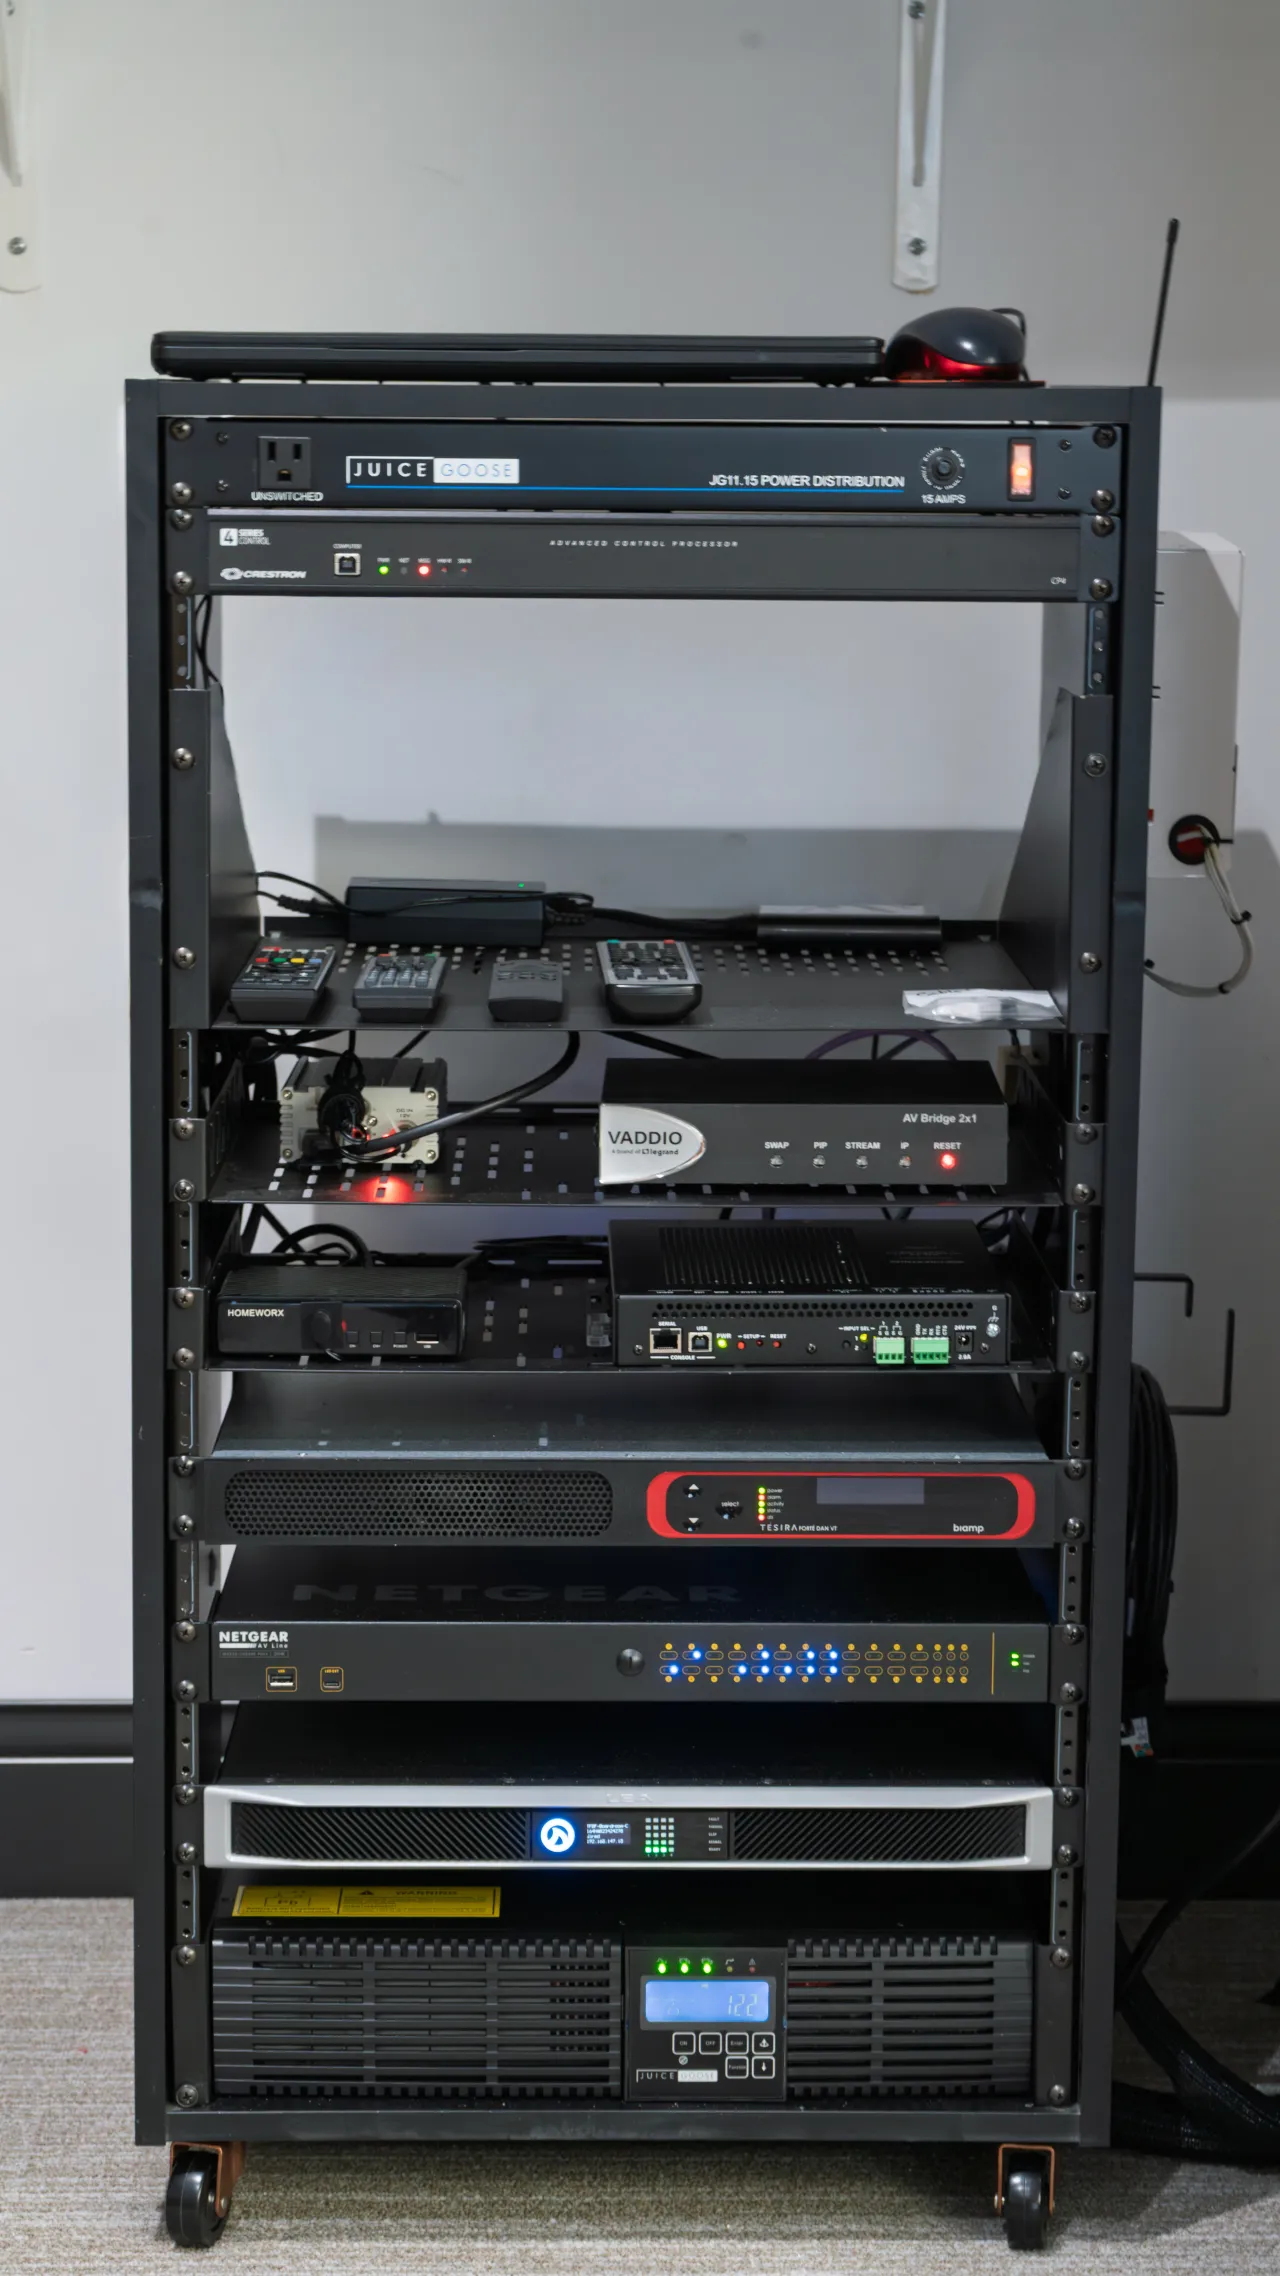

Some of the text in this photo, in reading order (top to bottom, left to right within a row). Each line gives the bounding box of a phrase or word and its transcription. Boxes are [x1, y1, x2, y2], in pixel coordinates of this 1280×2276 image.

[353, 462, 512, 477] JUICE GOOSE
[709, 474, 905, 488] JG11.15 POWER DISTRIBUTION
[250, 491, 324, 502] UNSWITCHED
[921, 494, 966, 504] 15 AMPS
[238, 528, 264, 537] SERIES
[238, 537, 271, 546] CONTROL
[549, 539, 739, 548] ADVANCED CONTROL PROCESSOR
[242, 570, 307, 579] CRESTRON
[902, 1113, 977, 1126] AV Bridge 2x1
[608, 1131, 682, 1145] VADDIO
[764, 1141, 790, 1149] SWAP
[813, 1141, 828, 1149] PIP
[845, 1141, 881, 1149] STREAM
[650, 1148, 679, 1156] legrand
[227, 1309, 284, 1317] HOMEWORX
[953, 1523, 984, 1534] biamp
[293, 1583, 742, 1602] NETGEAR
[218, 1631, 289, 1643] NETGEAR
[727, 1994, 758, 2017] 122
[640, 2072, 675, 2080] JUICE
